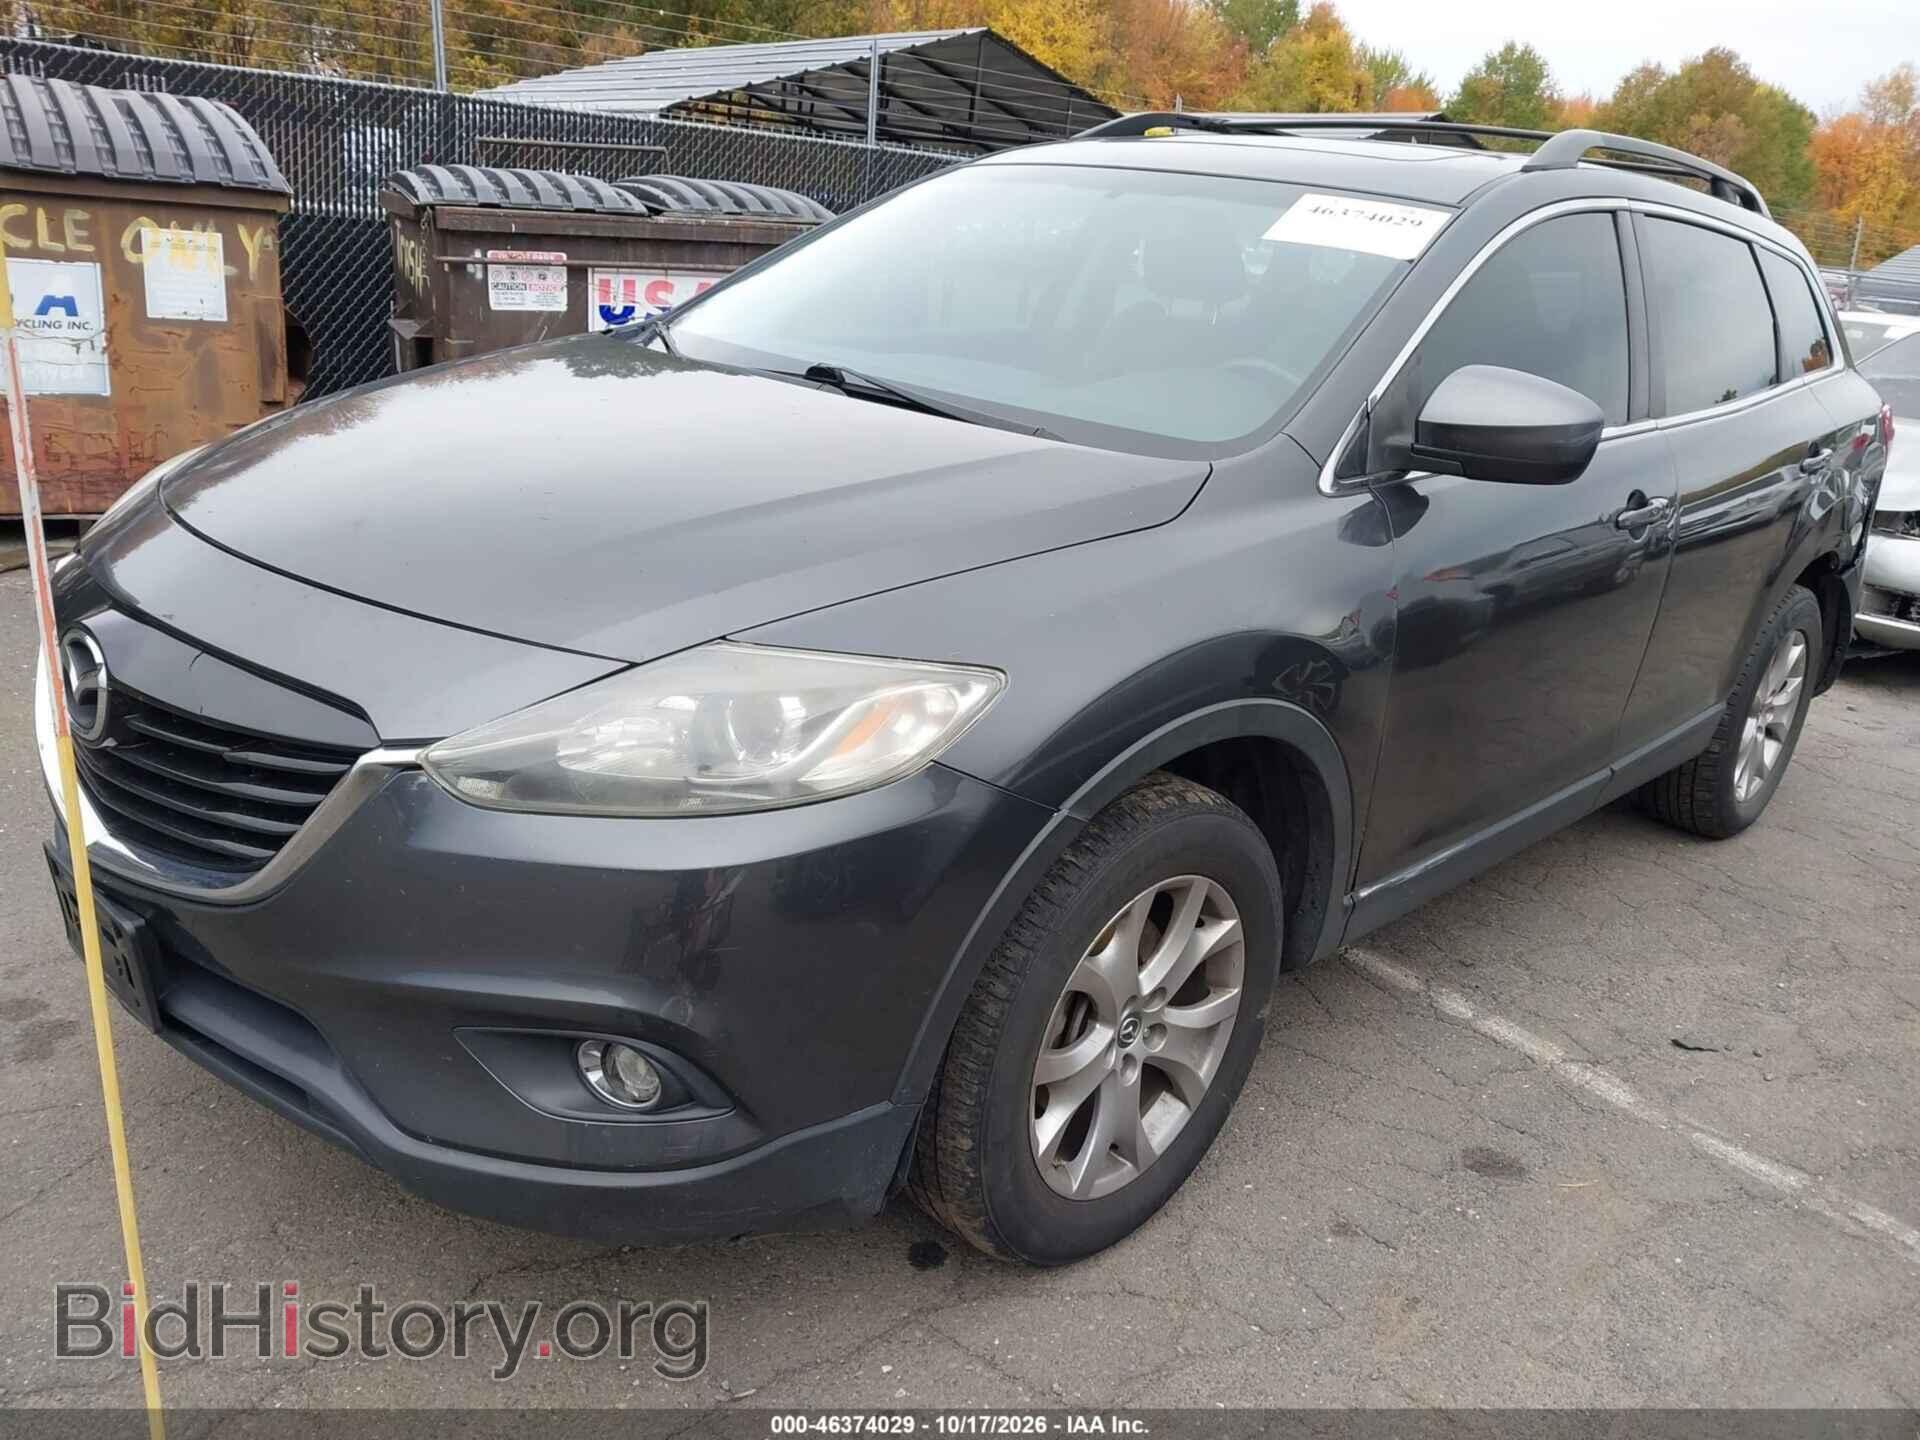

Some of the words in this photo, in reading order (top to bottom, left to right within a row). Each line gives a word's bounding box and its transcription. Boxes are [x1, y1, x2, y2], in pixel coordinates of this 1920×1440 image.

[1306, 205, 1424, 227] 46374029
[598, 278, 712, 326] US
[67, 320, 94, 331] INC.
